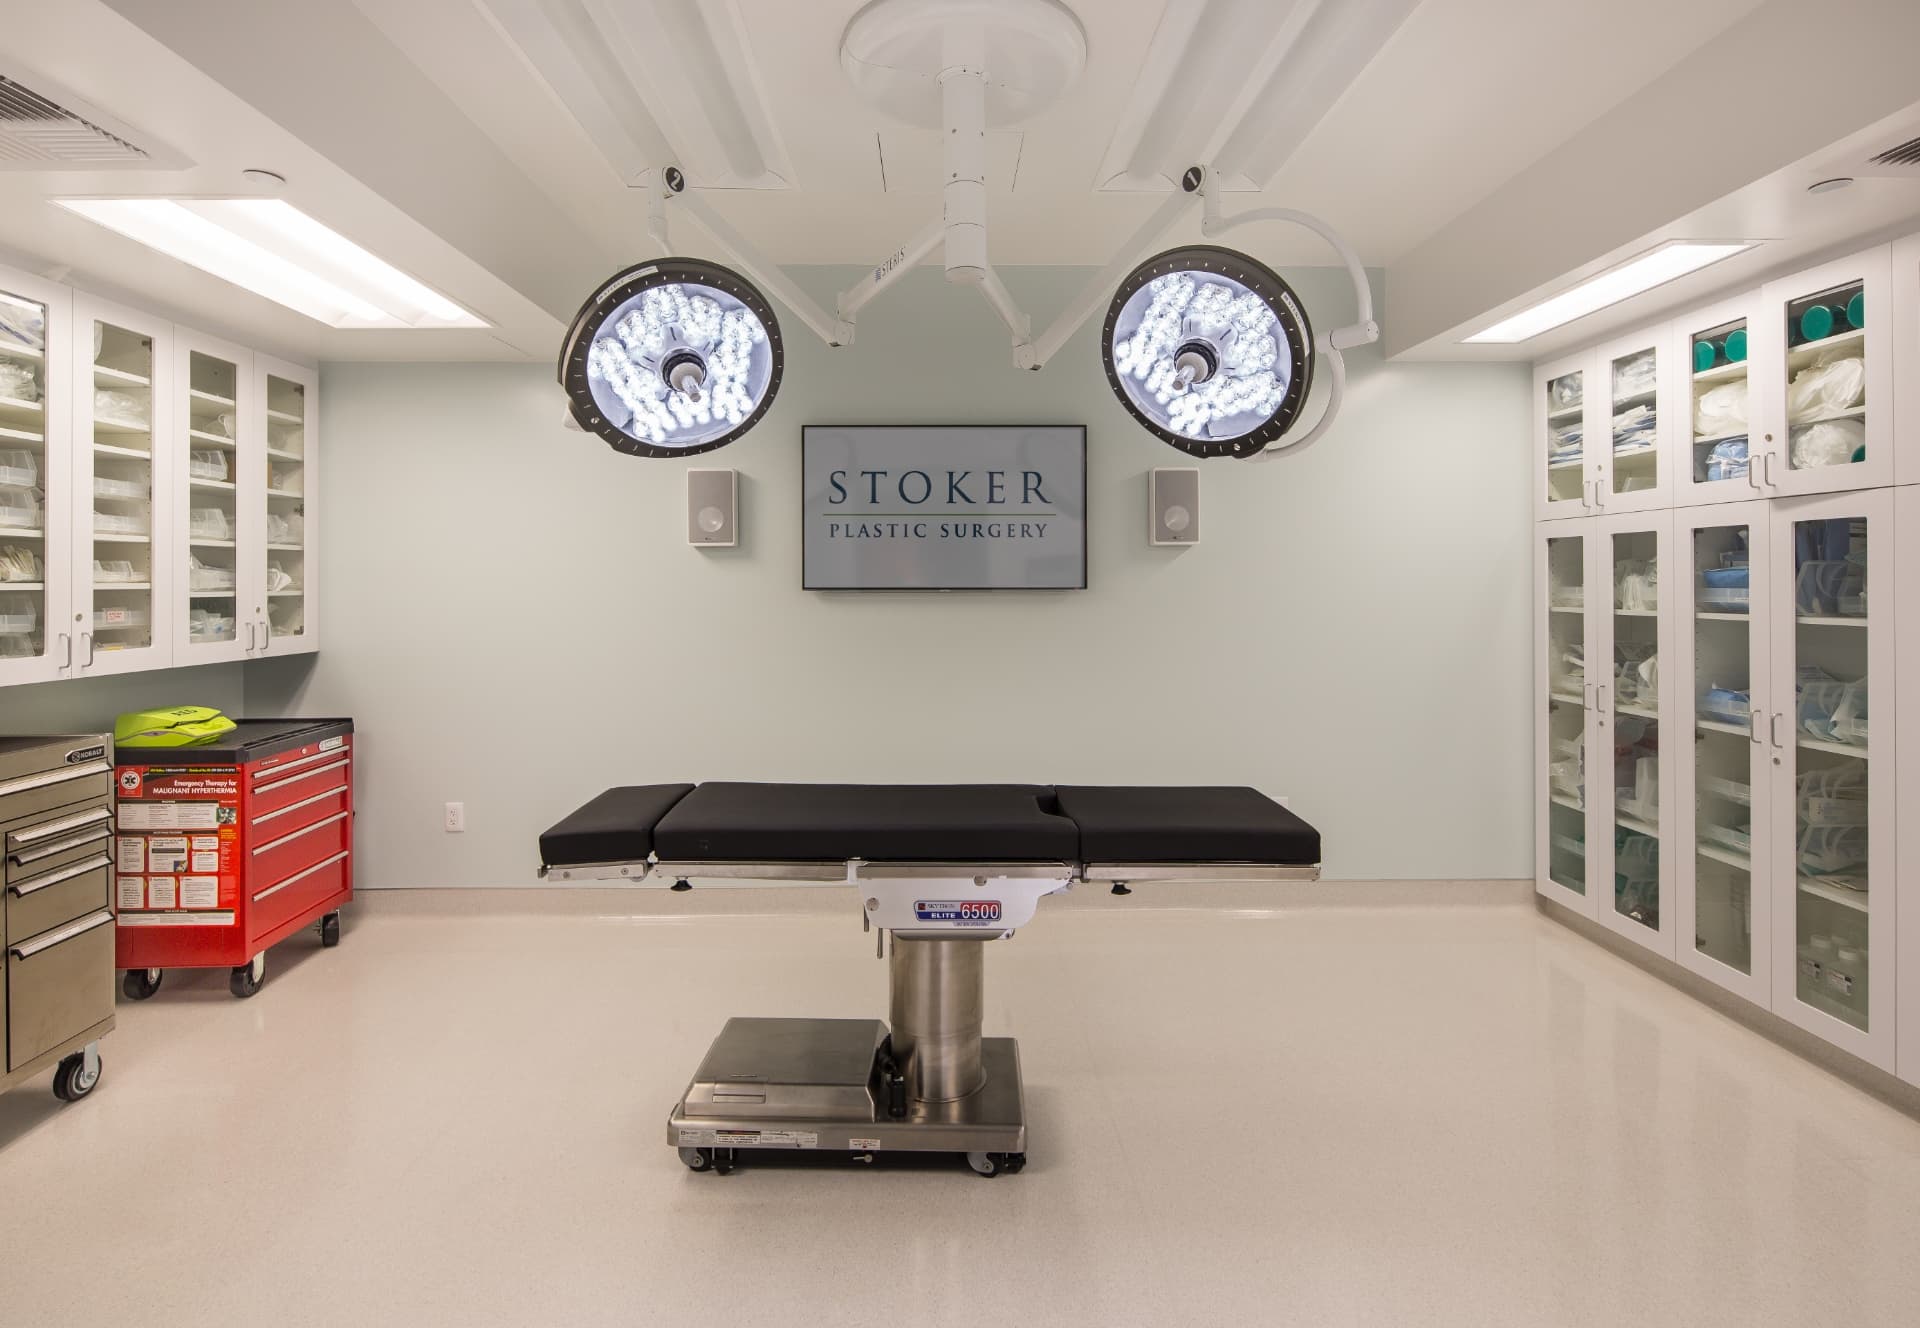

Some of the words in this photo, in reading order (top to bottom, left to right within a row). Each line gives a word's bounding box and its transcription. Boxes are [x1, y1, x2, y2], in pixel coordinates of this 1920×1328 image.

[670, 170, 681, 191] 2
[1186, 170, 1198, 187] 1
[828, 469, 1053, 505] STOKER
[829, 522, 928, 539] PLASTIC
[939, 522, 1049, 539] SURGERY
[174, 779, 204, 788] Emergency
[206, 779, 227, 788] Therapy
[228, 779, 237, 787] for
[961, 904, 999, 919] 6500
